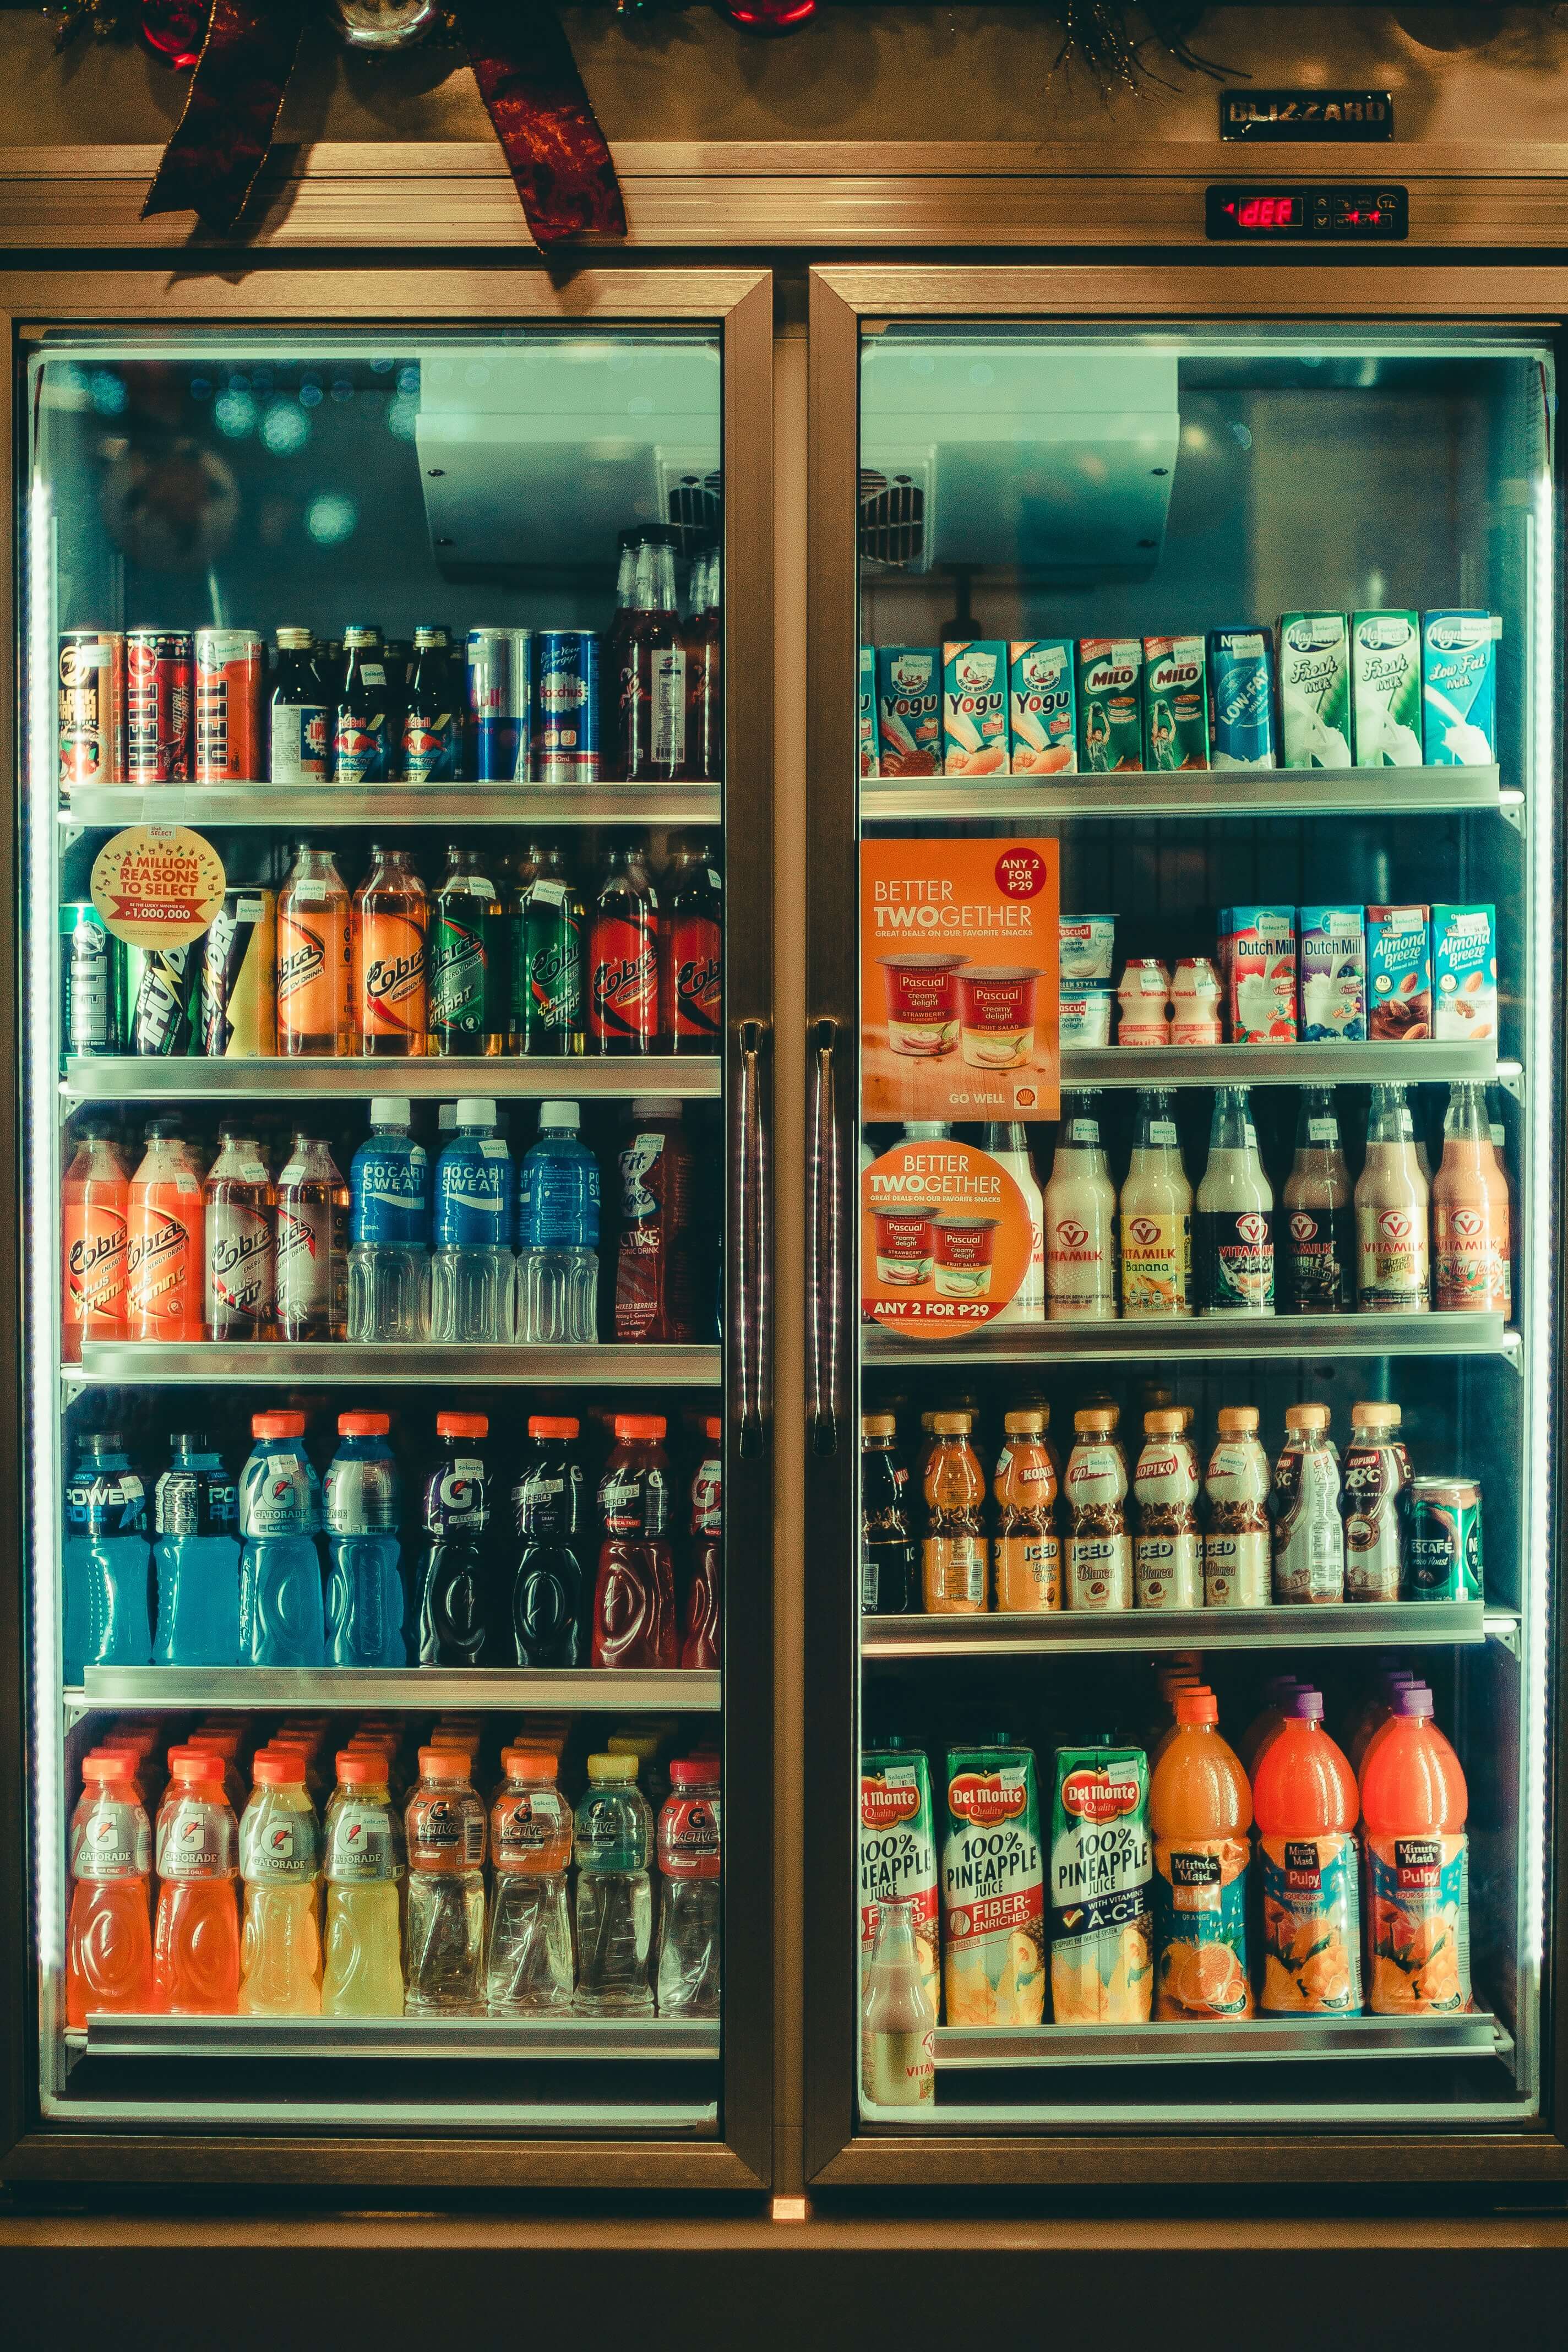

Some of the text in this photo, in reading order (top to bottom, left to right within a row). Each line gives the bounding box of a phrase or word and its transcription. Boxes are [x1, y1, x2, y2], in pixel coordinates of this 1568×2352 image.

[1290, 655, 1338, 684] Fresh
[1362, 654, 1409, 682] Fresh
[1428, 652, 1487, 681] Low Fat
[1092, 669, 1134, 687] MILO
[1156, 667, 1199, 685] MILO
[1304, 677, 1333, 694] Milk
[949, 693, 1003, 716] Yogu
[1016, 690, 1071, 715] Yogu
[1220, 667, 1270, 726] LOW-FAT
[883, 695, 937, 717] Yogu
[128, 682, 158, 768] HELL
[122, 857, 198, 869] A MILLION
[1001, 859, 1040, 869] ANY 2
[119, 868, 199, 883] REASONS
[1008, 870, 1032, 880] FOR
[121, 882, 197, 896] TO SELECT
[874, 880, 954, 901] BETTER
[133, 908, 190, 919] 1,000,000
[873, 906, 1032, 928] TWOGETHER
[1238, 939, 1295, 956] Dutch Mill
[1304, 939, 1362, 955] Dutch Mill
[1373, 929, 1426, 959] Almond
[1438, 928, 1490, 957] Almond
[464, 954, 483, 970] DRINK
[1384, 947, 1421, 969] Breeze
[1449, 945, 1486, 968] Breeze
[592, 946, 658, 1000] Cobra
[902, 977, 945, 988] Pascual
[71, 956, 108, 1041] HELL
[548, 986, 573, 1009] PLUS
[908, 993, 938, 1001] creamy
[911, 998, 939, 1008] delight
[976, 990, 1019, 1001] Pascual
[982, 1006, 1011, 1014] creamy
[985, 1011, 1013, 1021] delight
[949, 1093, 1005, 1104] GO WELL
[363, 1166, 424, 1178] POCARI
[903, 1155, 969, 1173] BETTER
[443, 1167, 505, 1180] POCARI
[362, 1178, 421, 1191] SWEAT
[442, 1179, 499, 1192] SWEAT
[870, 1175, 1001, 1194] TWOGETHER
[889, 1222, 923, 1232] Pascual
[895, 1239, 918, 1248] delight
[946, 1234, 981, 1244] Pascual
[1364, 1241, 1424, 1253] VITAMILK
[167, 1244, 186, 1259] DRINK
[1123, 1249, 1176, 1260] VITAMILK
[1125, 1261, 1169, 1272] Banana
[226, 1276, 253, 1297] PLUS
[234, 1280, 262, 1309] FIT
[633, 1302, 657, 1310] BERRIES
[873, 1302, 907, 1315] ANY
[911, 1303, 922, 1315] 2
[925, 1304, 956, 1316] FOR
[1135, 1461, 1174, 1479] KOPIKO
[254, 1509, 307, 1520] GATORADE
[1023, 1542, 1058, 1561] ICED
[1073, 1542, 1114, 1560] ICED
[1137, 1542, 1174, 1560] ICED
[1077, 1564, 1115, 1581] Blanca
[1139, 1563, 1174, 1581] Blanca
[871, 1792, 916, 1806] Monte
[952, 1789, 1022, 1804] Del Monte
[1067, 1785, 1135, 1801] Del Monte
[864, 1807, 897, 1820] Quality
[970, 1804, 1003, 1817] Quality
[1084, 1801, 1117, 1814] Quality
[420, 1823, 459, 1834] ACTIVE
[503, 1825, 546, 1837] ACTIVE
[579, 1822, 616, 1833] ACTIVE
[677, 1830, 717, 1842] ACTIVE
[1075, 1828, 1136, 1859] 100%
[961, 1832, 1023, 1862] 100%
[1399, 1844, 1439, 1854] Minute
[79, 1850, 133, 1861] GATORADE
[164, 1851, 218, 1863] GATORADE
[253, 1856, 306, 1869] GATORADE
[330, 1854, 382, 1864] GATORADE
[1404, 1854, 1435, 1865] Maid
[946, 1846, 1037, 1892] PINEAPPLE
[1059, 1842, 1148, 1889] PINEAPPLE
[1180, 1870, 1213, 1881] Maid
[1289, 1871, 1320, 1888] Pulpy
[1402, 1869, 1440, 1886] Pulpy
[870, 1881, 898, 1901] JUICE
[973, 1879, 1004, 1899] JUICE
[1087, 1876, 1116, 1896] JUICE
[1088, 1888, 1144, 1910] WITH VITAMINS
[973, 1897, 1031, 1920] FIBER-
[1087, 1898, 1145, 1929] A-C-E
[973, 1910, 1031, 1933] ENRICHED
[906, 2062, 935, 2077] VITA
